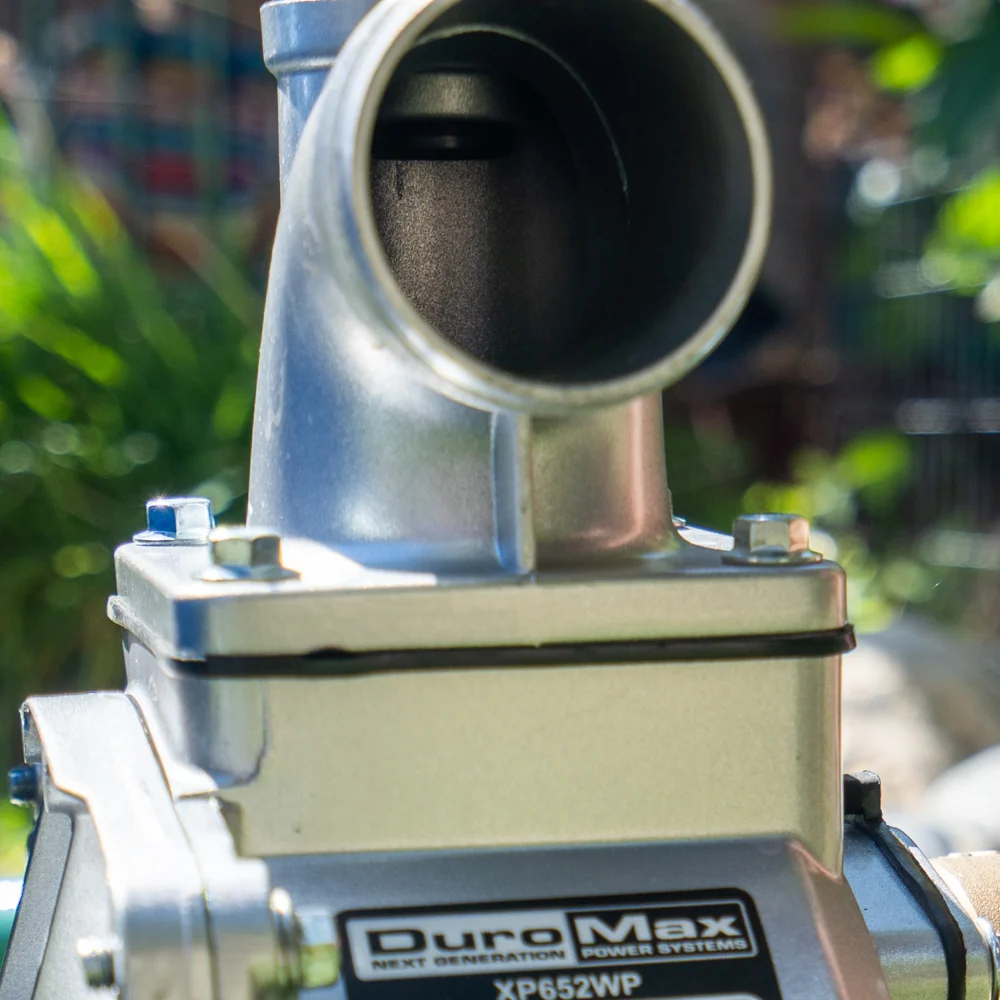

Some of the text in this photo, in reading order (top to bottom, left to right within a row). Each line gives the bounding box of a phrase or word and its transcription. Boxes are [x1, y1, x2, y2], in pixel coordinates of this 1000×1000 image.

[581, 937, 748, 959] POWER SYSTEMS
[373, 950, 566, 971] NEXT GENERATION
